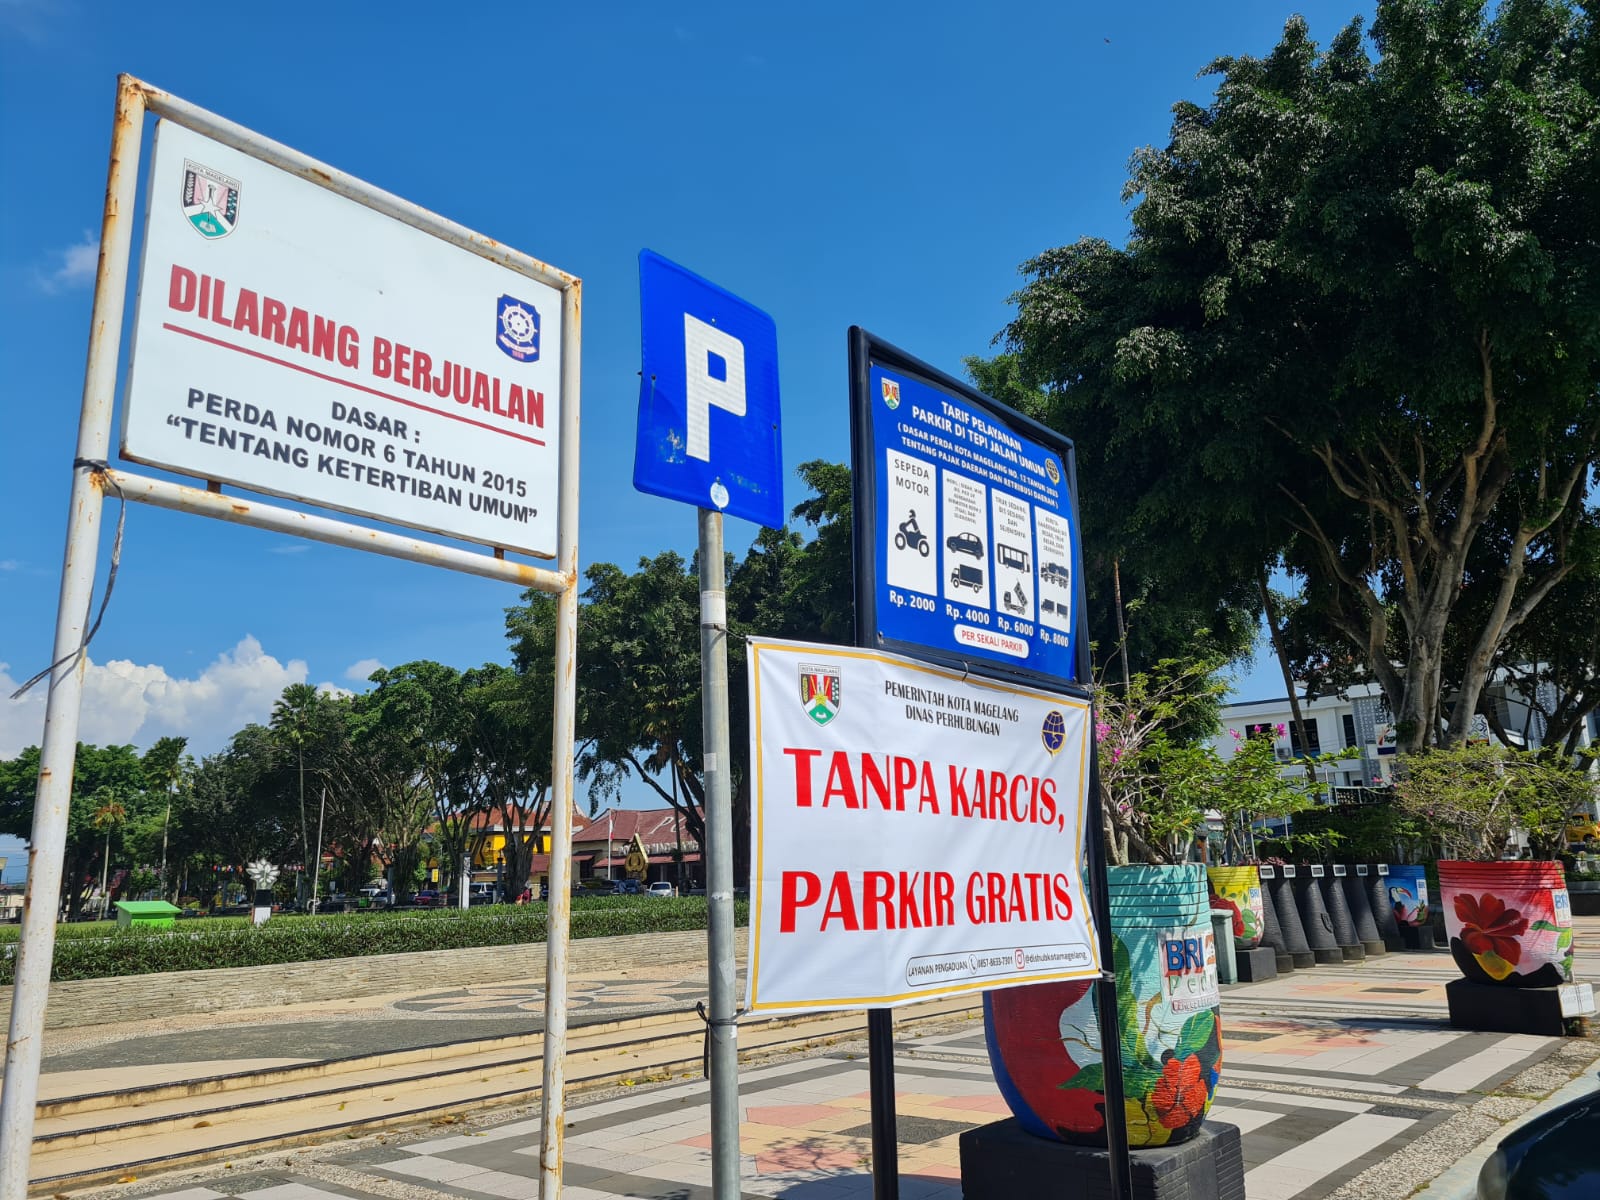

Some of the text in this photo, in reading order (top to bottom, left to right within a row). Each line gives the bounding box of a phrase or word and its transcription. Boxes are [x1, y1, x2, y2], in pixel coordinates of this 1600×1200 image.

[168, 264, 544, 429] DILARANG BERJUALAN
[684, 312, 746, 463] P
[331, 400, 408, 440] DASAR
[941, 401, 1022, 452] TARIF PELAYANAN
[187, 388, 526, 498] PERDA NOMOR 6 TAHUN 2015
[903, 424, 929, 441] DASAR
[930, 433, 953, 450] PERDA
[955, 443, 972, 458] KOTA
[973, 453, 1007, 474] MAGELANG
[912, 405, 1046, 477] PARKIR DI TEPI JALAN UMUM
[317, 453, 461, 507] KETERTIBAN
[894, 459, 929, 480] SEPEDA
[896, 476, 929, 497] MOTOR
[902, 437, 936, 457] TENTANG
[938, 452, 960, 467] PAJAK
[962, 461, 988, 477] DAERAH
[989, 471, 1002, 484] DAN
[1004, 475, 1033, 496] RETRIBUSI
[889, 590, 935, 612] Rp. 2000
[946, 604, 989, 625] Rp. 4000
[961, 629, 1023, 653] PER SEKALI PARKIR
[998, 616, 1034, 637] Rp. 6000
[1040, 628, 1069, 648] Rp. 8000
[885, 680, 1019, 722] PEMERINTAH KOTA MAGELANG
[906, 705, 1000, 736] DINAS PERHUBUNGAN
[783, 747, 1065, 833] TANPA KARCIS,
[779, 870, 1073, 933] PARKIR GRATIS
[908, 964, 934, 977] LAYANAN
[935, 961, 968, 973] PENGADUAN
[1165, 937, 1205, 976] BRI
